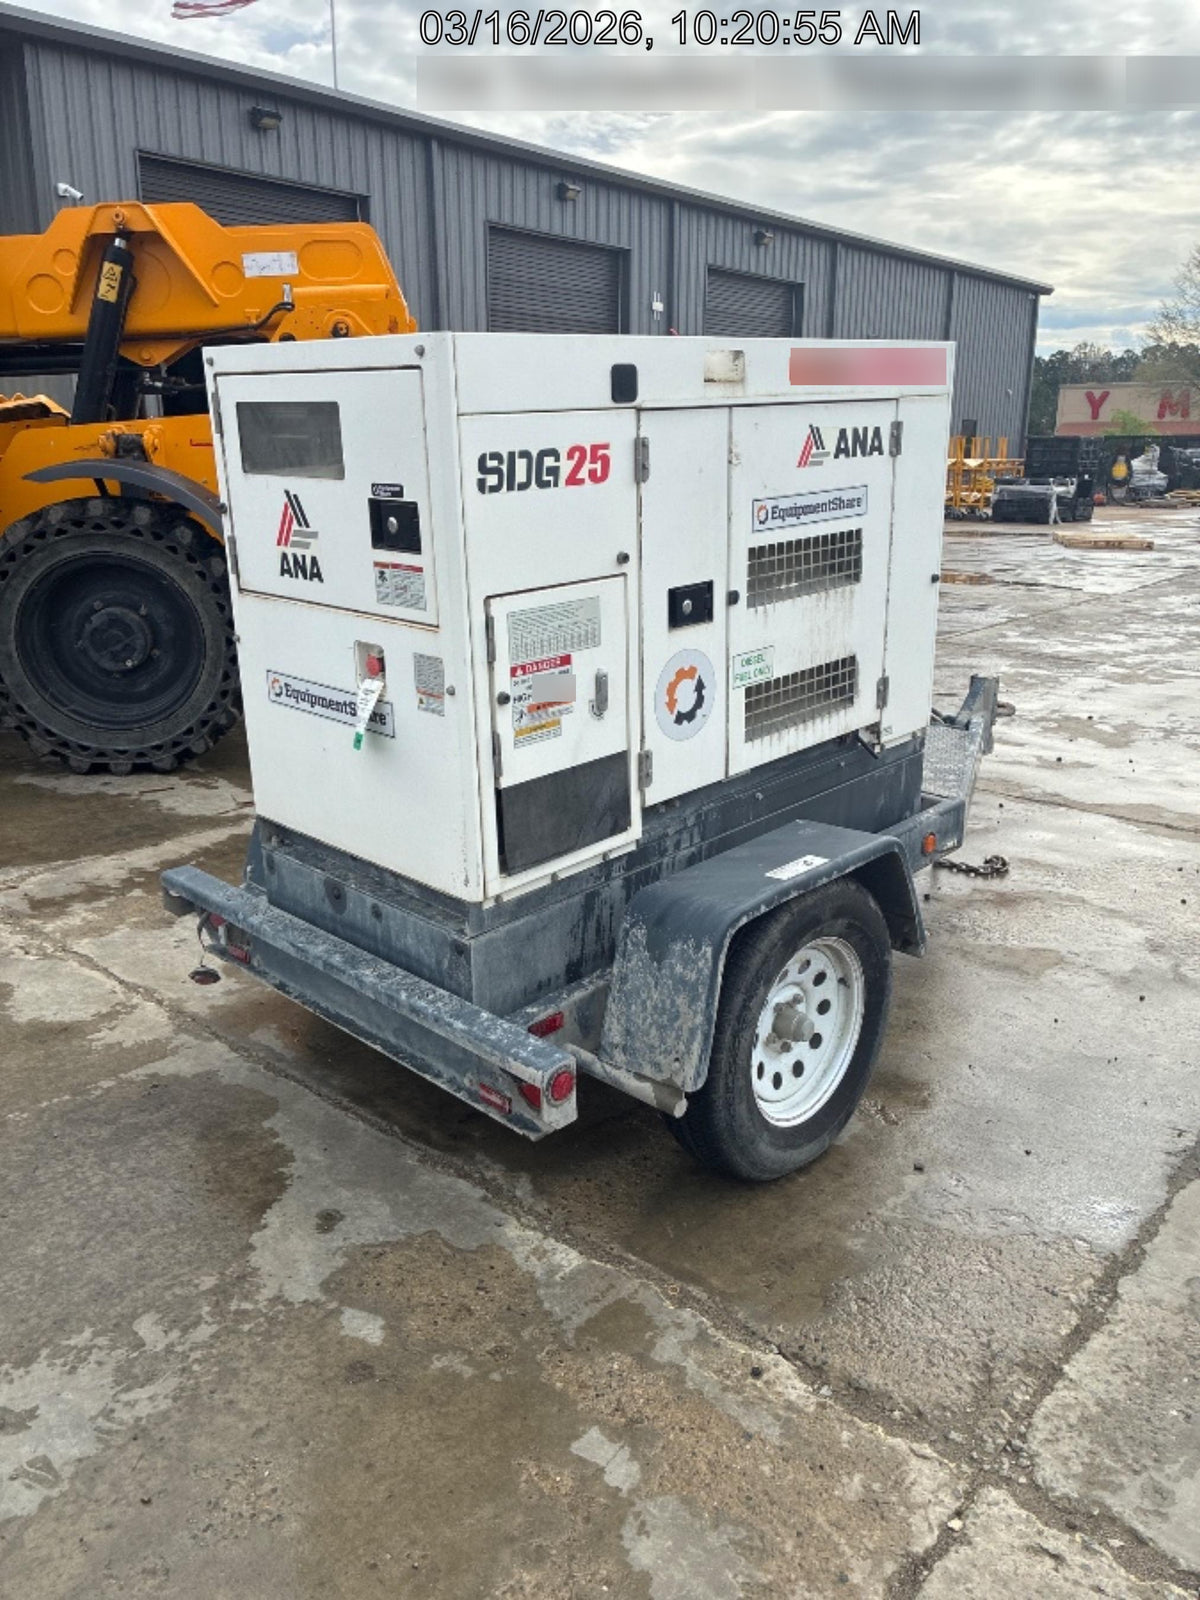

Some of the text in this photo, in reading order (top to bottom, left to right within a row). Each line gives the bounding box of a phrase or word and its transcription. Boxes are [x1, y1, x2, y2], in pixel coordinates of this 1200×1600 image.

[1085, 389, 1190, 420] Y M
[834, 426, 884, 460] ANA
[477, 442, 611, 495] SDG25
[771, 496, 863, 522] EquipmentShare
[279, 552, 324, 583] ANA
